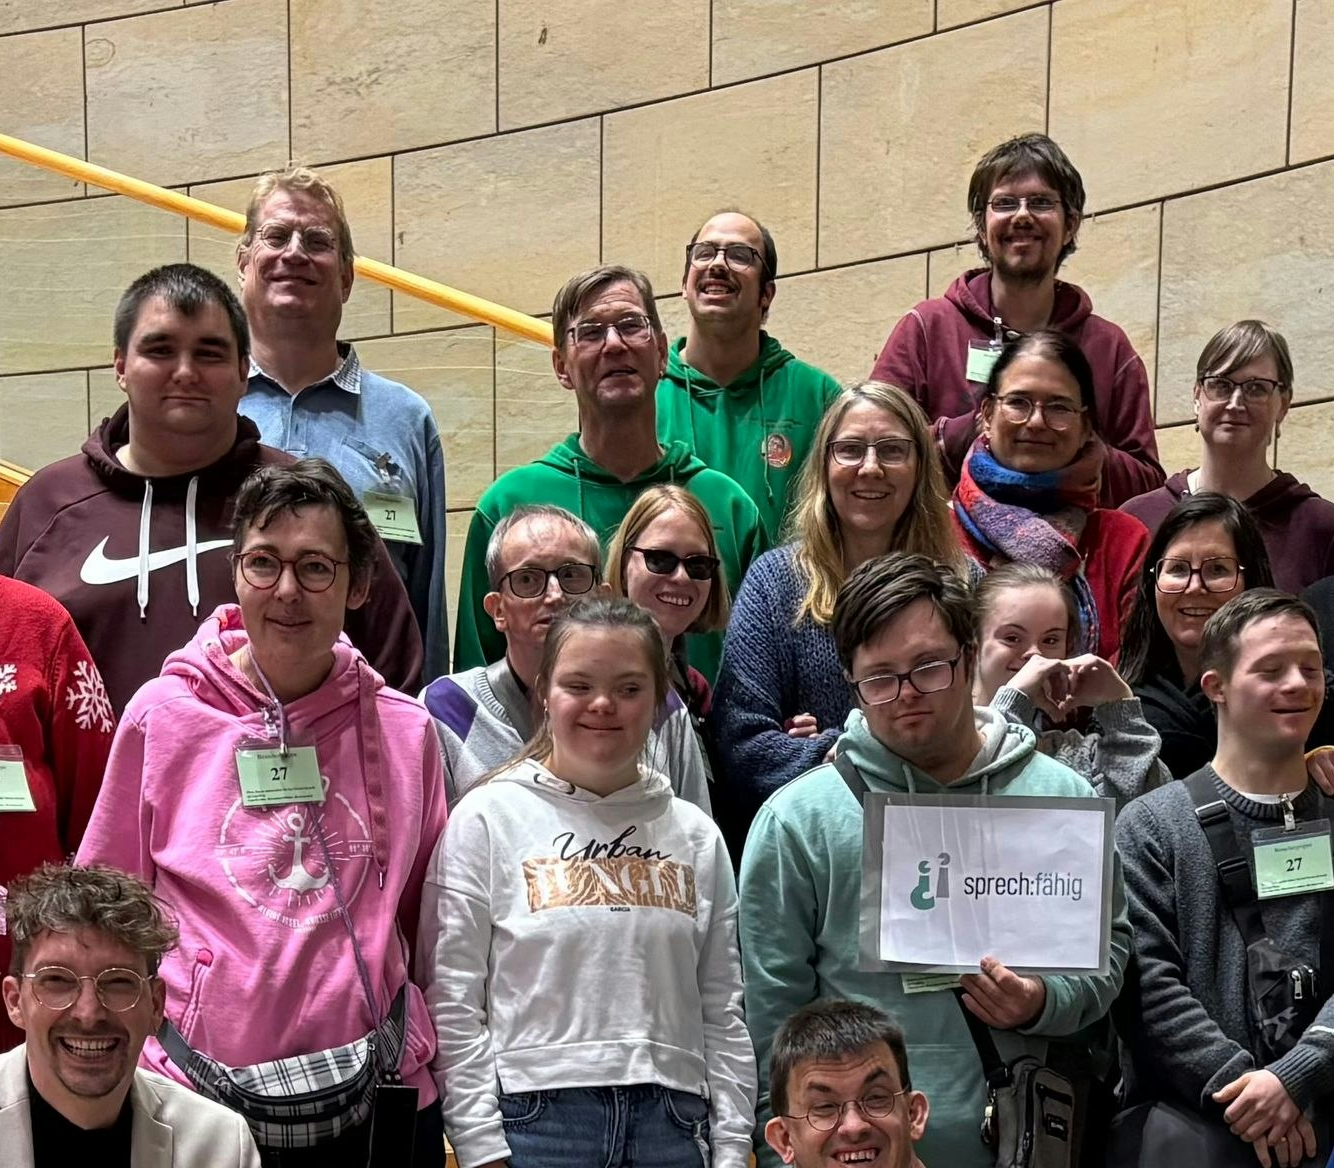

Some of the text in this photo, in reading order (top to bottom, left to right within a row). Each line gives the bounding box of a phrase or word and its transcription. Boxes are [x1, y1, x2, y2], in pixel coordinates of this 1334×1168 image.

[384, 509, 396, 521] 27
[270, 766, 288, 781] 27
[552, 825, 672, 861] Urban
[1285, 857, 1303, 872] 27
[963, 872, 1083, 901] sprech:fähig
